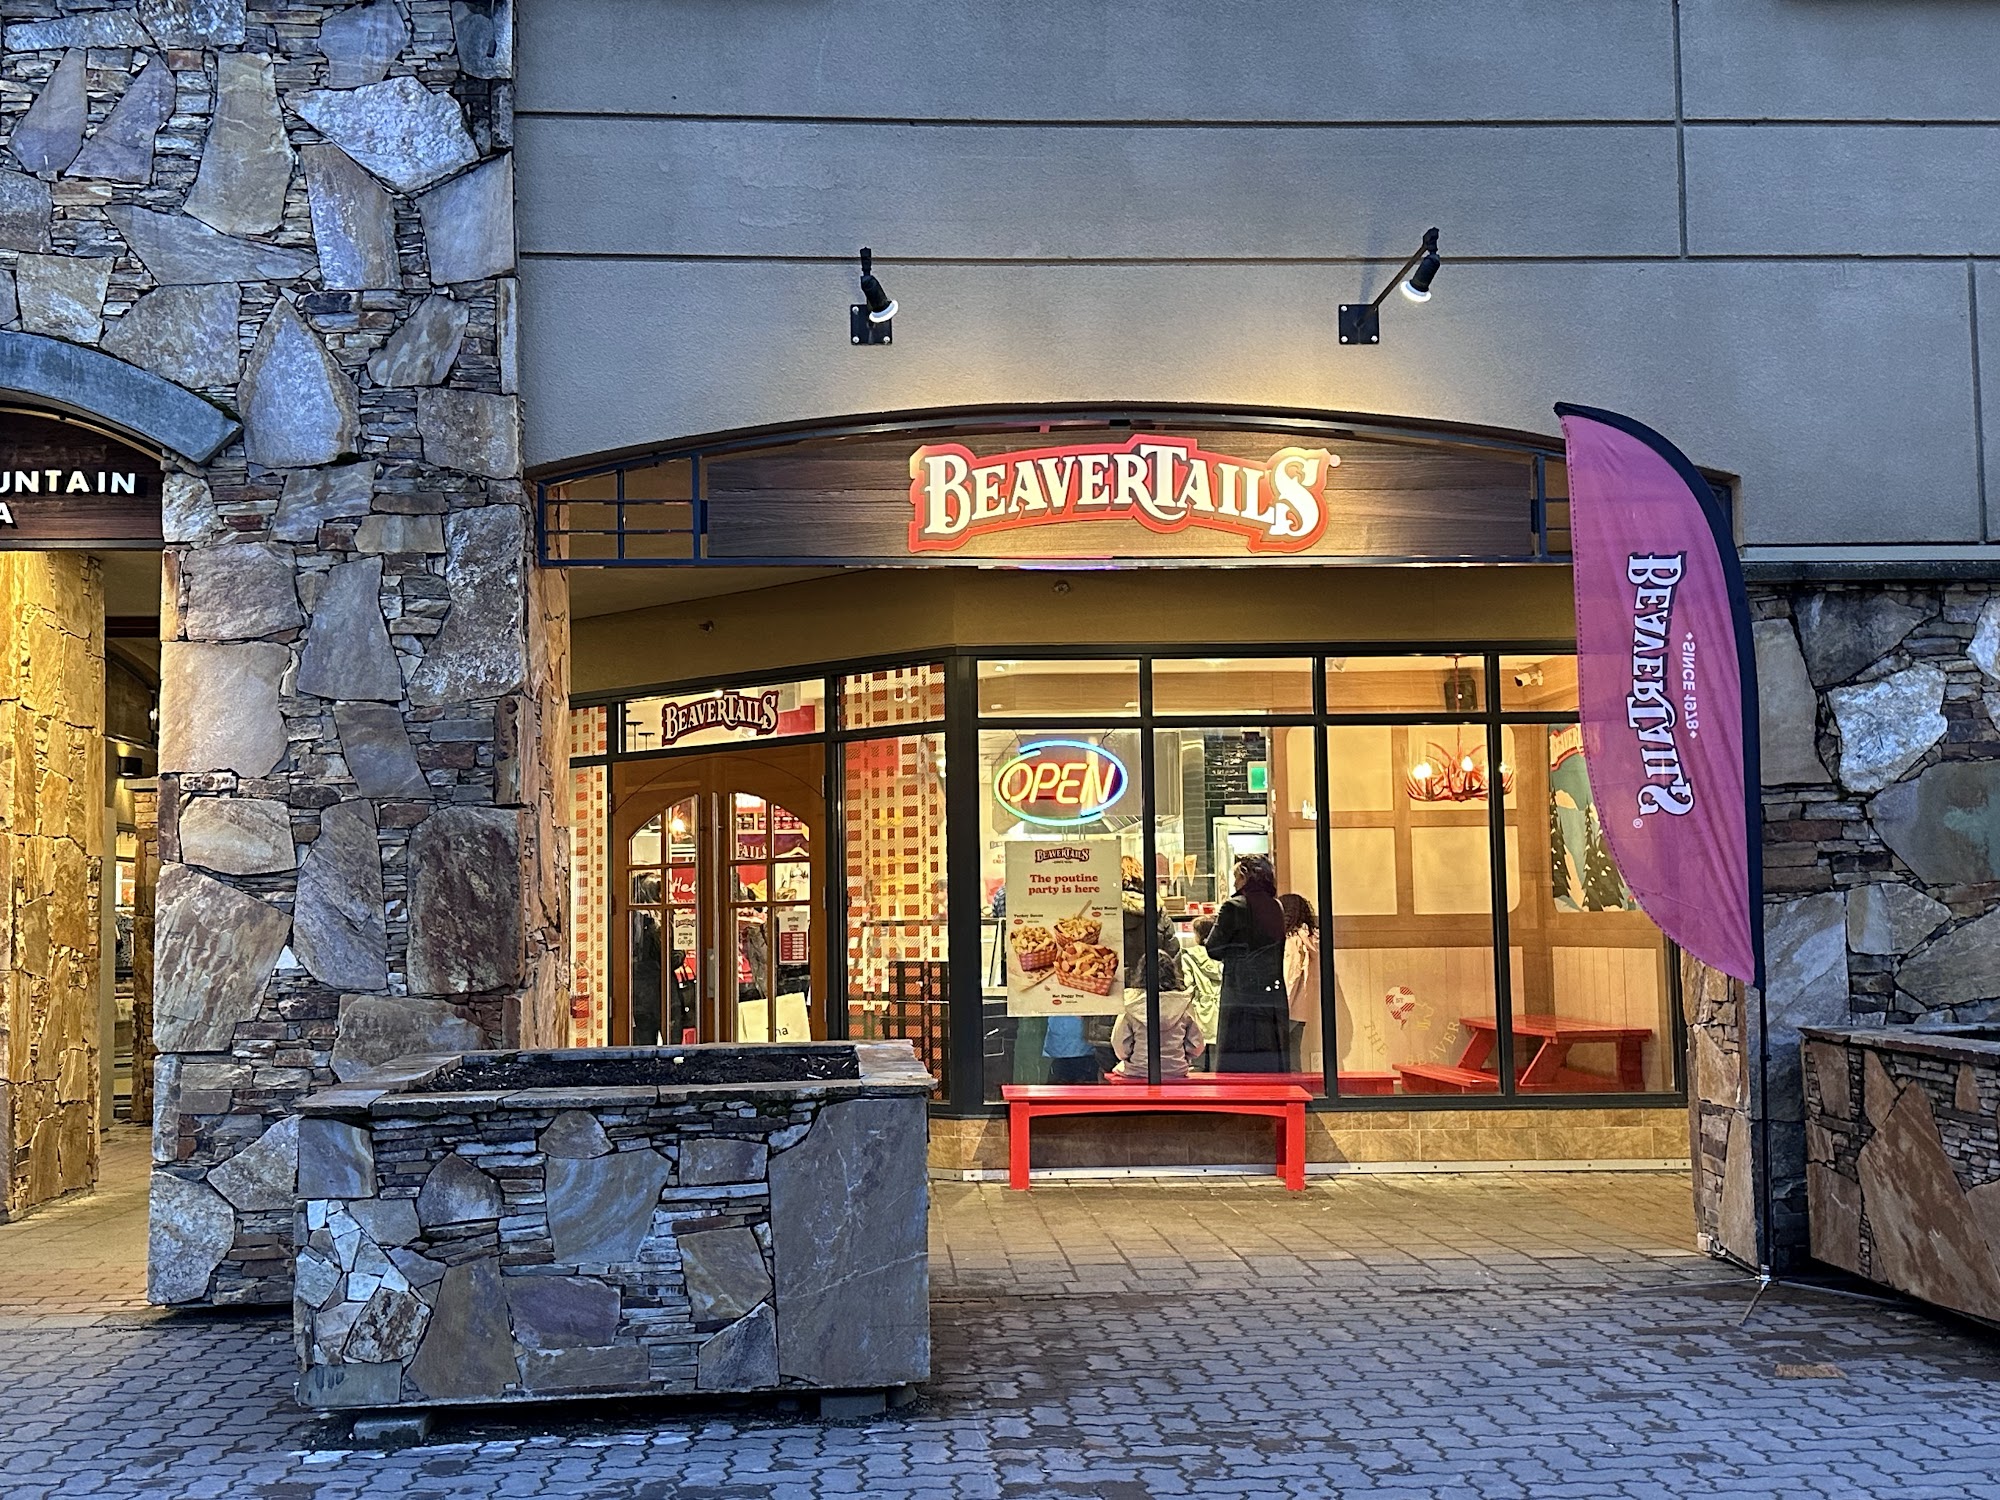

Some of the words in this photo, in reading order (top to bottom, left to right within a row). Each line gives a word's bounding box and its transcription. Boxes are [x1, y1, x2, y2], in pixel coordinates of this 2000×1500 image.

[920, 443, 1322, 539] BEAVERTAILS
[663, 692, 778, 742] BEAVERTAILS
[1001, 762, 1116, 804] OPEN
[1035, 847, 1090, 863] BEAVERTAILS
[1028, 886, 1059, 896] party
[1062, 885, 1072, 893] is
[1074, 885, 1100, 893] here
[1030, 874, 1051, 883] The
[1054, 874, 1099, 884] poutine
